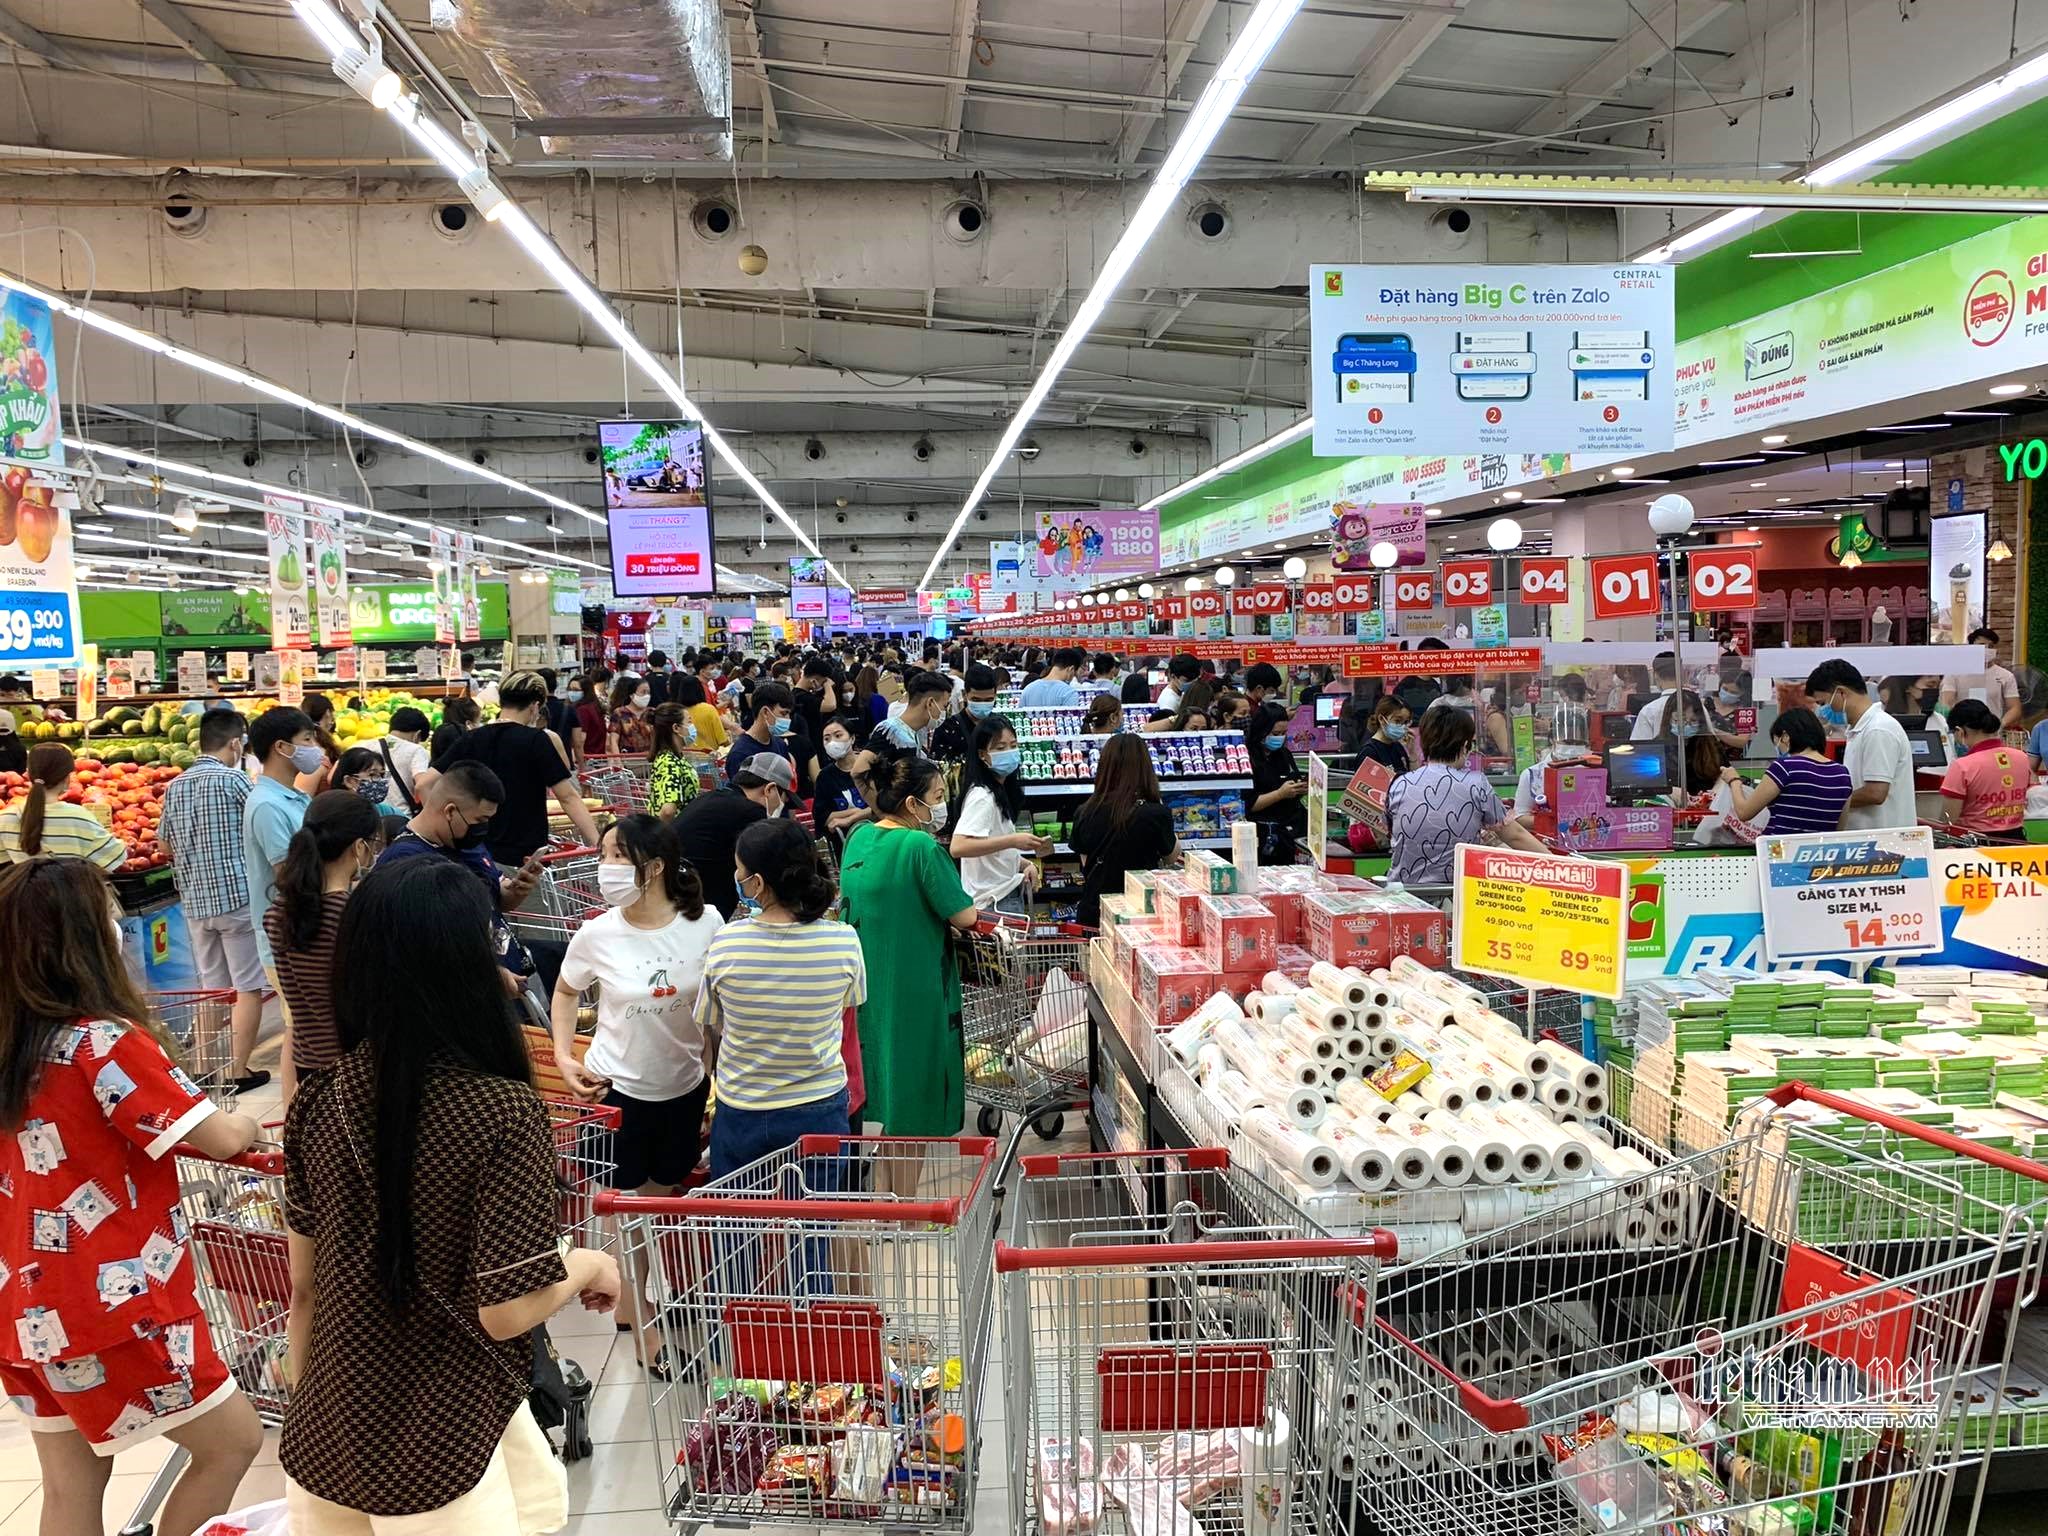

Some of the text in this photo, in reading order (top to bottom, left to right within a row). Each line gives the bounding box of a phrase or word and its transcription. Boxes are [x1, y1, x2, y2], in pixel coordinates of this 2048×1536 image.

[1613, 270, 1662, 279] CENTRAL
[1620, 280, 1655, 289] RETAIL
[1379, 284, 1610, 308] Đặt hàng Big C trên Zalo
[1464, 313, 1487, 322] 10km
[1761, 344, 1789, 364] ĐÚNG
[1343, 359, 1354, 369] Big
[1382, 359, 1399, 368] Long
[1476, 356, 1518, 369] ĐẶT HÀNG
[1676, 357, 1715, 381] PHỤC VỤ
[1827, 358, 1837, 367] SAI
[1680, 378, 1716, 395] serve you
[1463, 457, 1477, 470] CAM
[1403, 468, 1419, 485] 1800
[1111, 527, 1153, 540] 1900
[1111, 542, 1153, 555] 1880
[7, 567, 46, 576] NEW ZEALAND
[631, 563, 695, 575] 30 TRIỆU ĐỒNG
[1447, 572, 1488, 596] 03
[1523, 569, 1567, 594] 04
[1602, 569, 1650, 603] 01
[1695, 564, 1753, 596] 02
[1336, 585, 1369, 604] 05
[1398, 583, 1431, 601] 06
[1192, 597, 1216, 610] 09
[1236, 596, 1254, 609] 10
[1256, 592, 1284, 607] 07
[1307, 592, 1334, 606] 08
[1085, 610, 1096, 619] 17
[1101, 609, 1114, 618] 15
[1123, 605, 1137, 616] 13
[1169, 602, 1182, 614] 11
[1056, 614, 1065, 622] 21
[1071, 611, 1081, 620] 19
[1418, 652, 1439, 662] được
[1499, 649, 1519, 658] toàn
[1457, 658, 1478, 668] khách
[1625, 812, 1659, 822] 1900
[1627, 823, 1659, 832] 1880
[1797, 842, 1868, 863] BẢO VỆ
[1836, 863, 1867, 877] ĐÌNH
[1945, 861, 2048, 879] CENTRA
[1479, 891, 1523, 903] GREEN ECO
[1839, 887, 1866, 898] TAY
[1870, 885, 1906, 896] THSH
[1962, 882, 2042, 900] RETAIL
[1551, 900, 1599, 913] GREEN ECO
[1827, 902, 1882, 915] SIZE M,L
[1485, 916, 1533, 931] 49.900 vnđ
[1843, 913, 1923, 948] 14 .900
[1894, 930, 1920, 942] vnđ
[1487, 939, 1534, 960] 35 .000
[1515, 952, 1532, 961] vnđ
[1560, 949, 1612, 970] 89 .900
[1595, 965, 1612, 974] vnđ
